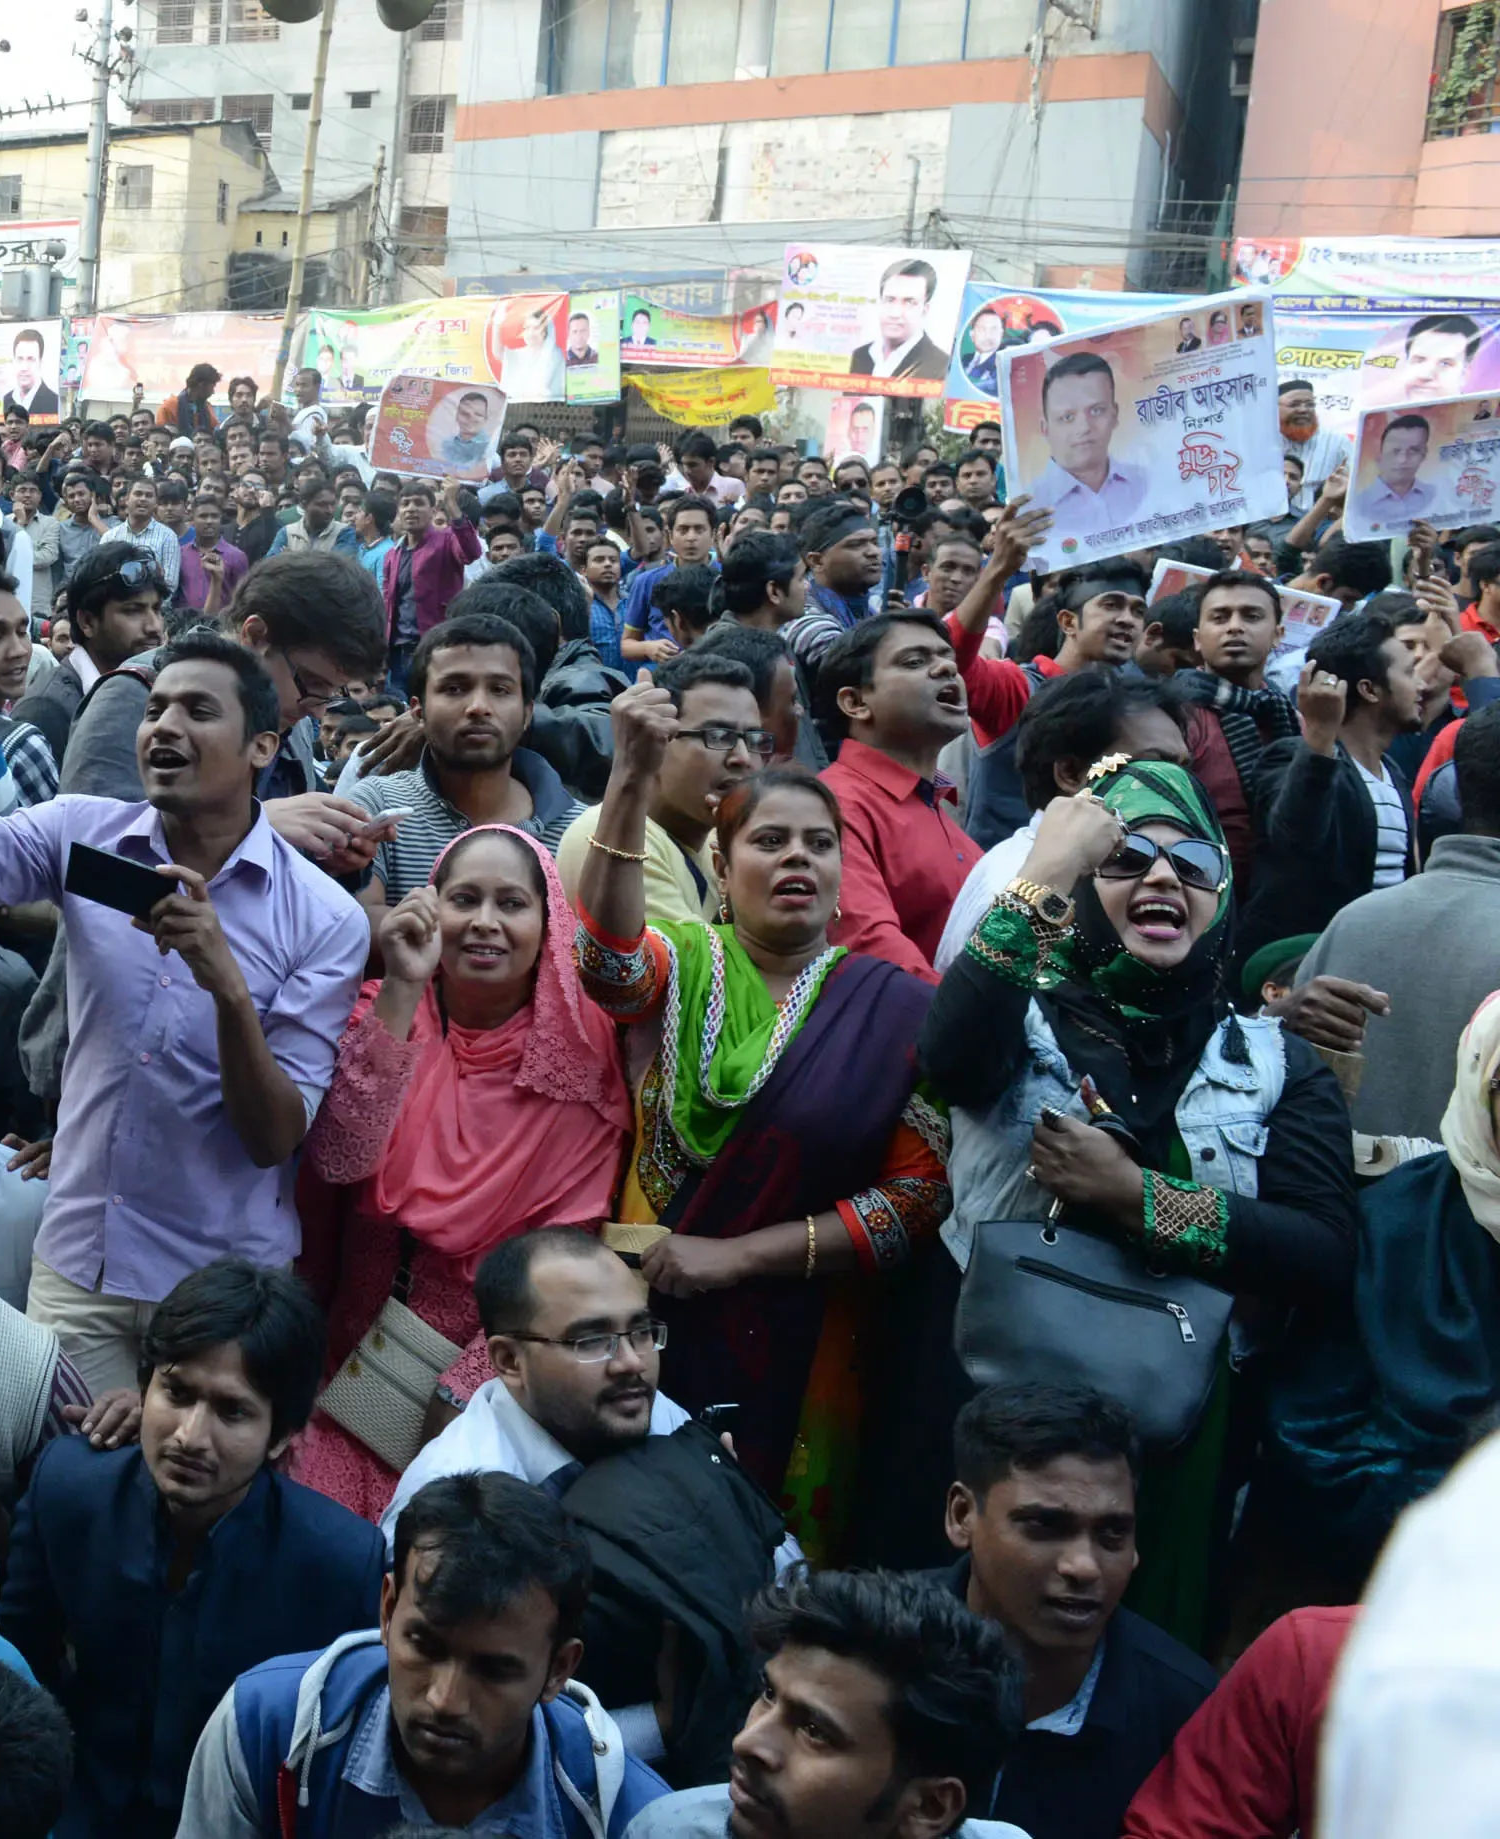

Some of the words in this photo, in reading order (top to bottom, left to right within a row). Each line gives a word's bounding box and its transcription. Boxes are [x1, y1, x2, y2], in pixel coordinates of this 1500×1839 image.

[1177, 366, 1221, 384] সভাপতি
[1276, 345, 1365, 370] সোহেল
[1134, 384, 1187, 424] রাজীব
[1192, 374, 1256, 408] আহসান
[1183, 409, 1225, 432] নিঃশর্ত
[1177, 431, 1224, 481] মুক্তি
[1205, 450, 1243, 497] চাই
[1084, 523, 1134, 547] বাংলাদেশ
[1135, 502, 1206, 535] জাতীয়তাবাদী
